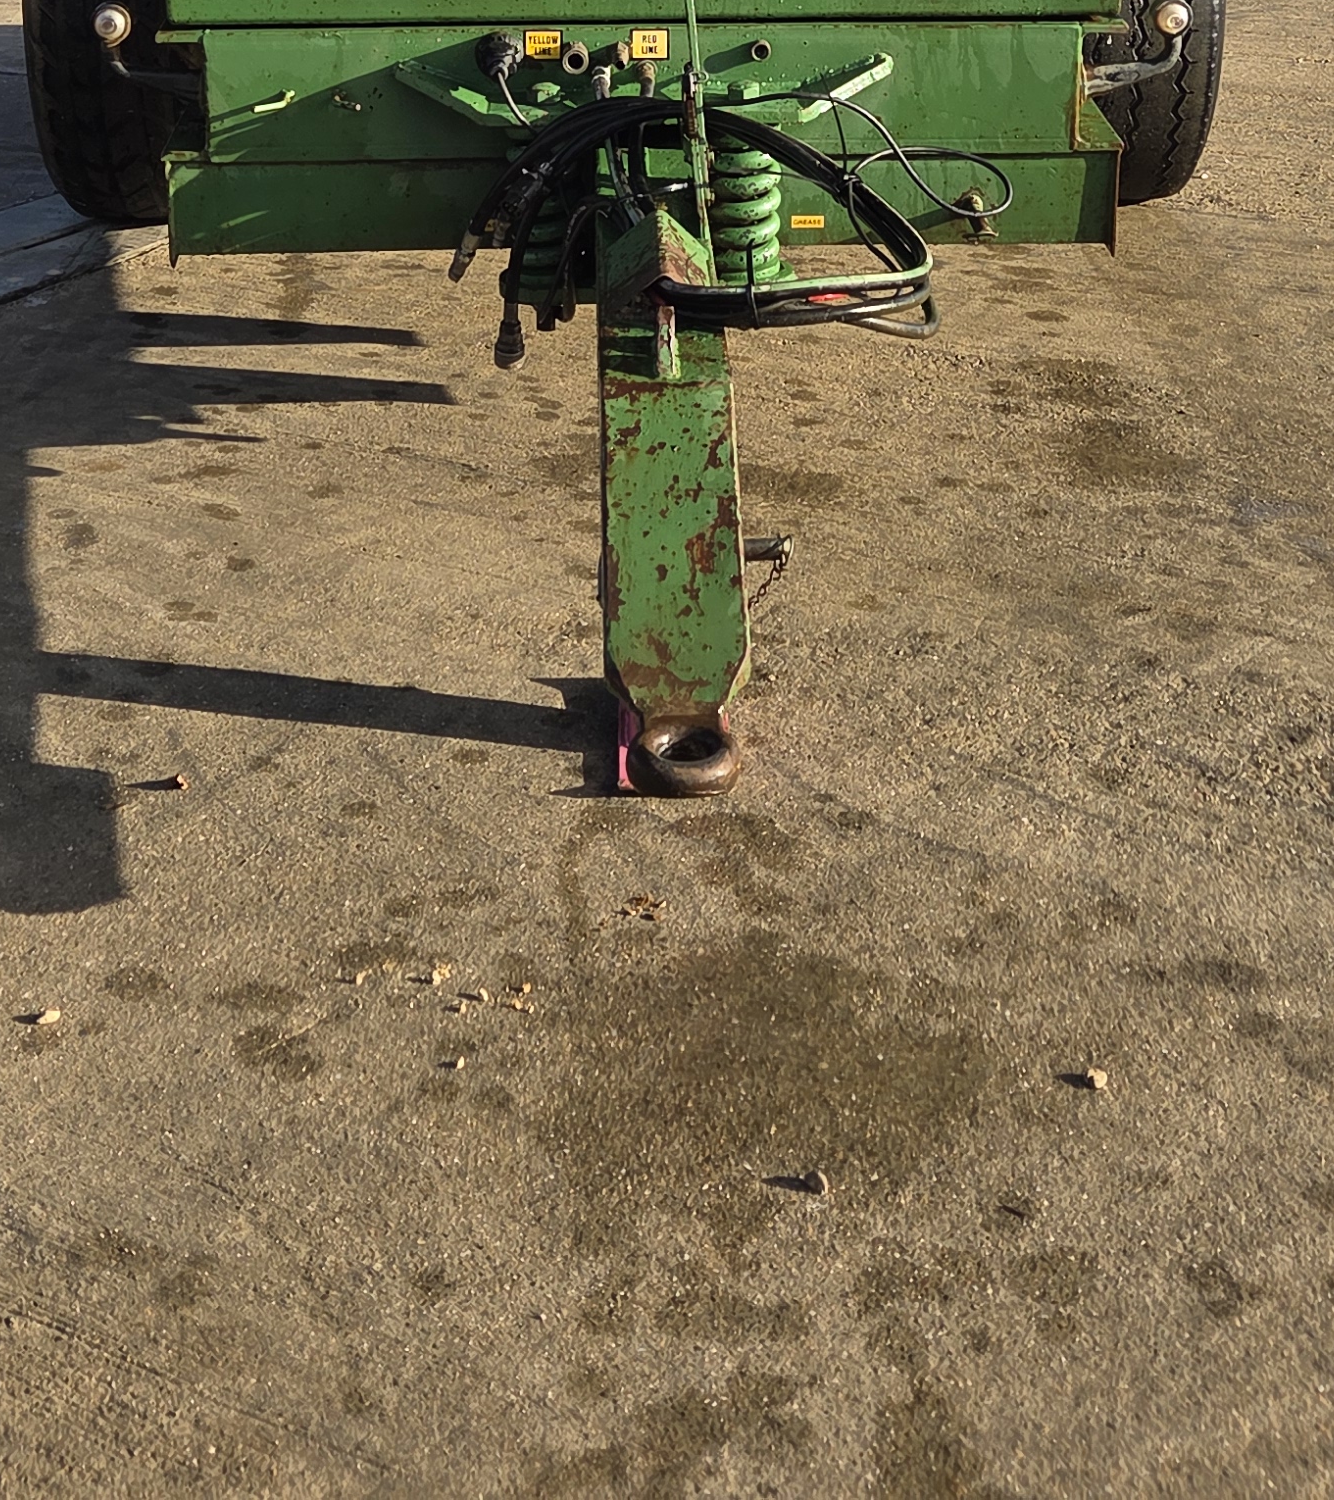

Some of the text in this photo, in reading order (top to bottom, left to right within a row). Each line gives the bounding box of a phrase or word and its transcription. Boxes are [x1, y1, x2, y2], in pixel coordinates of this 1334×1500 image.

[528, 35, 559, 45] YELLOW
[641, 34, 657, 44] RED
[534, 46, 552, 56] LINE
[641, 45, 658, 54] LINE
